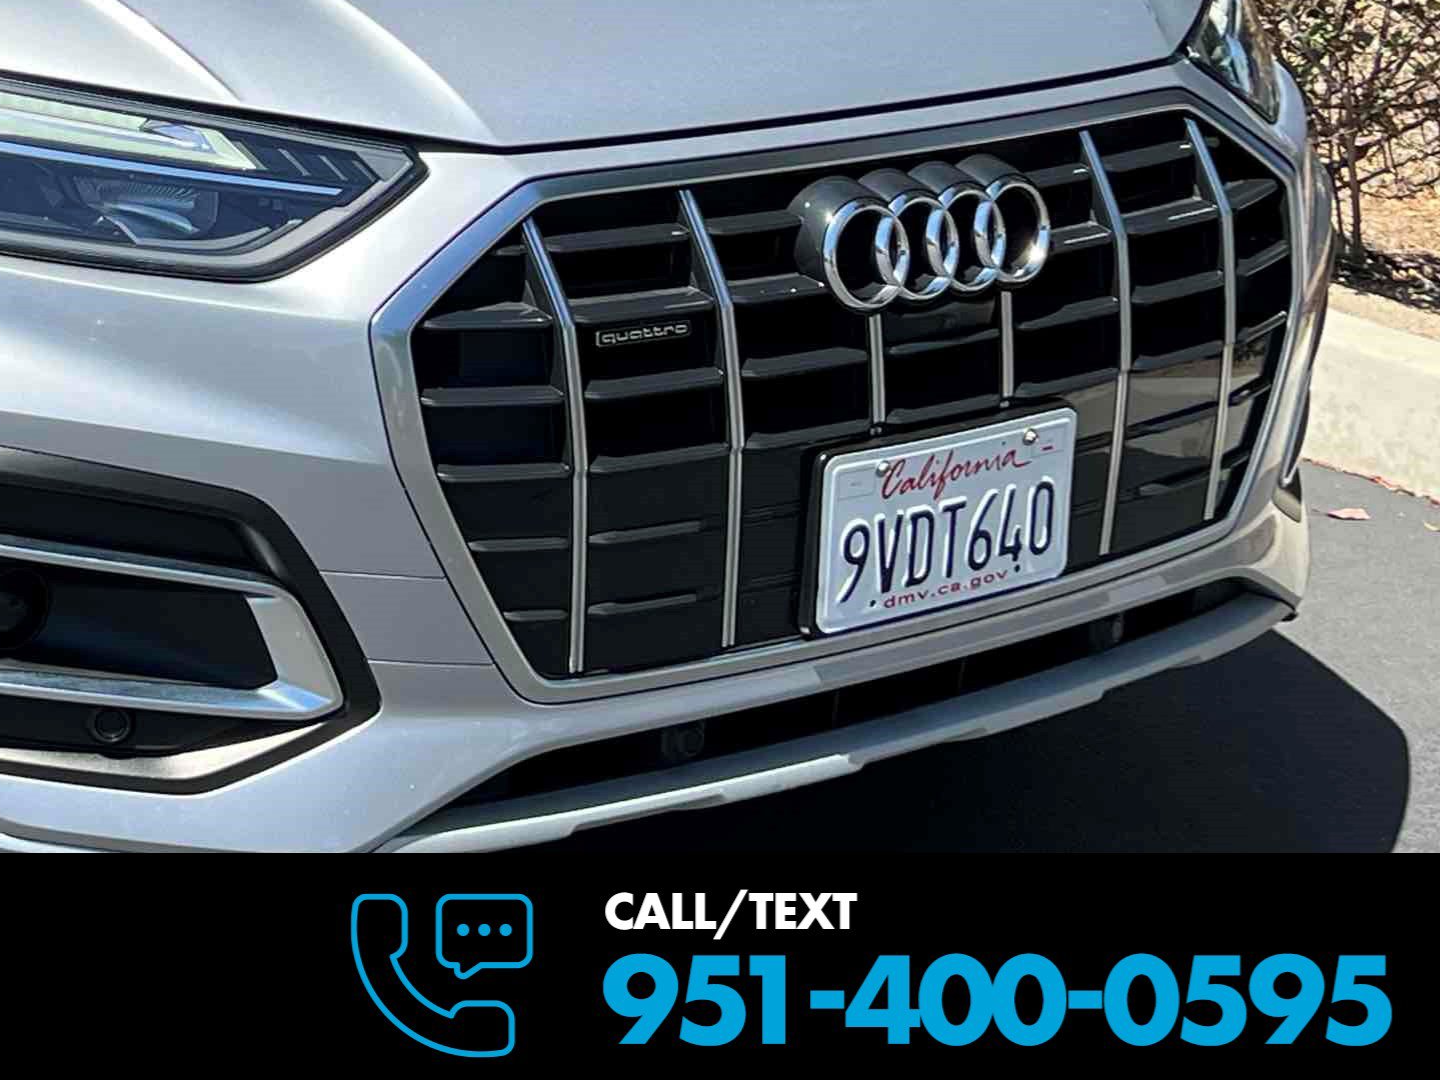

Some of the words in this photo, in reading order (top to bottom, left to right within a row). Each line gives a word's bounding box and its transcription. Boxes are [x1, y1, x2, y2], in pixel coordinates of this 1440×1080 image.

[602, 323, 688, 344] quattro
[880, 449, 1034, 501] California
[836, 476, 1056, 605] 9VDT640
[883, 569, 1009, 609] dmv.ca.gov
